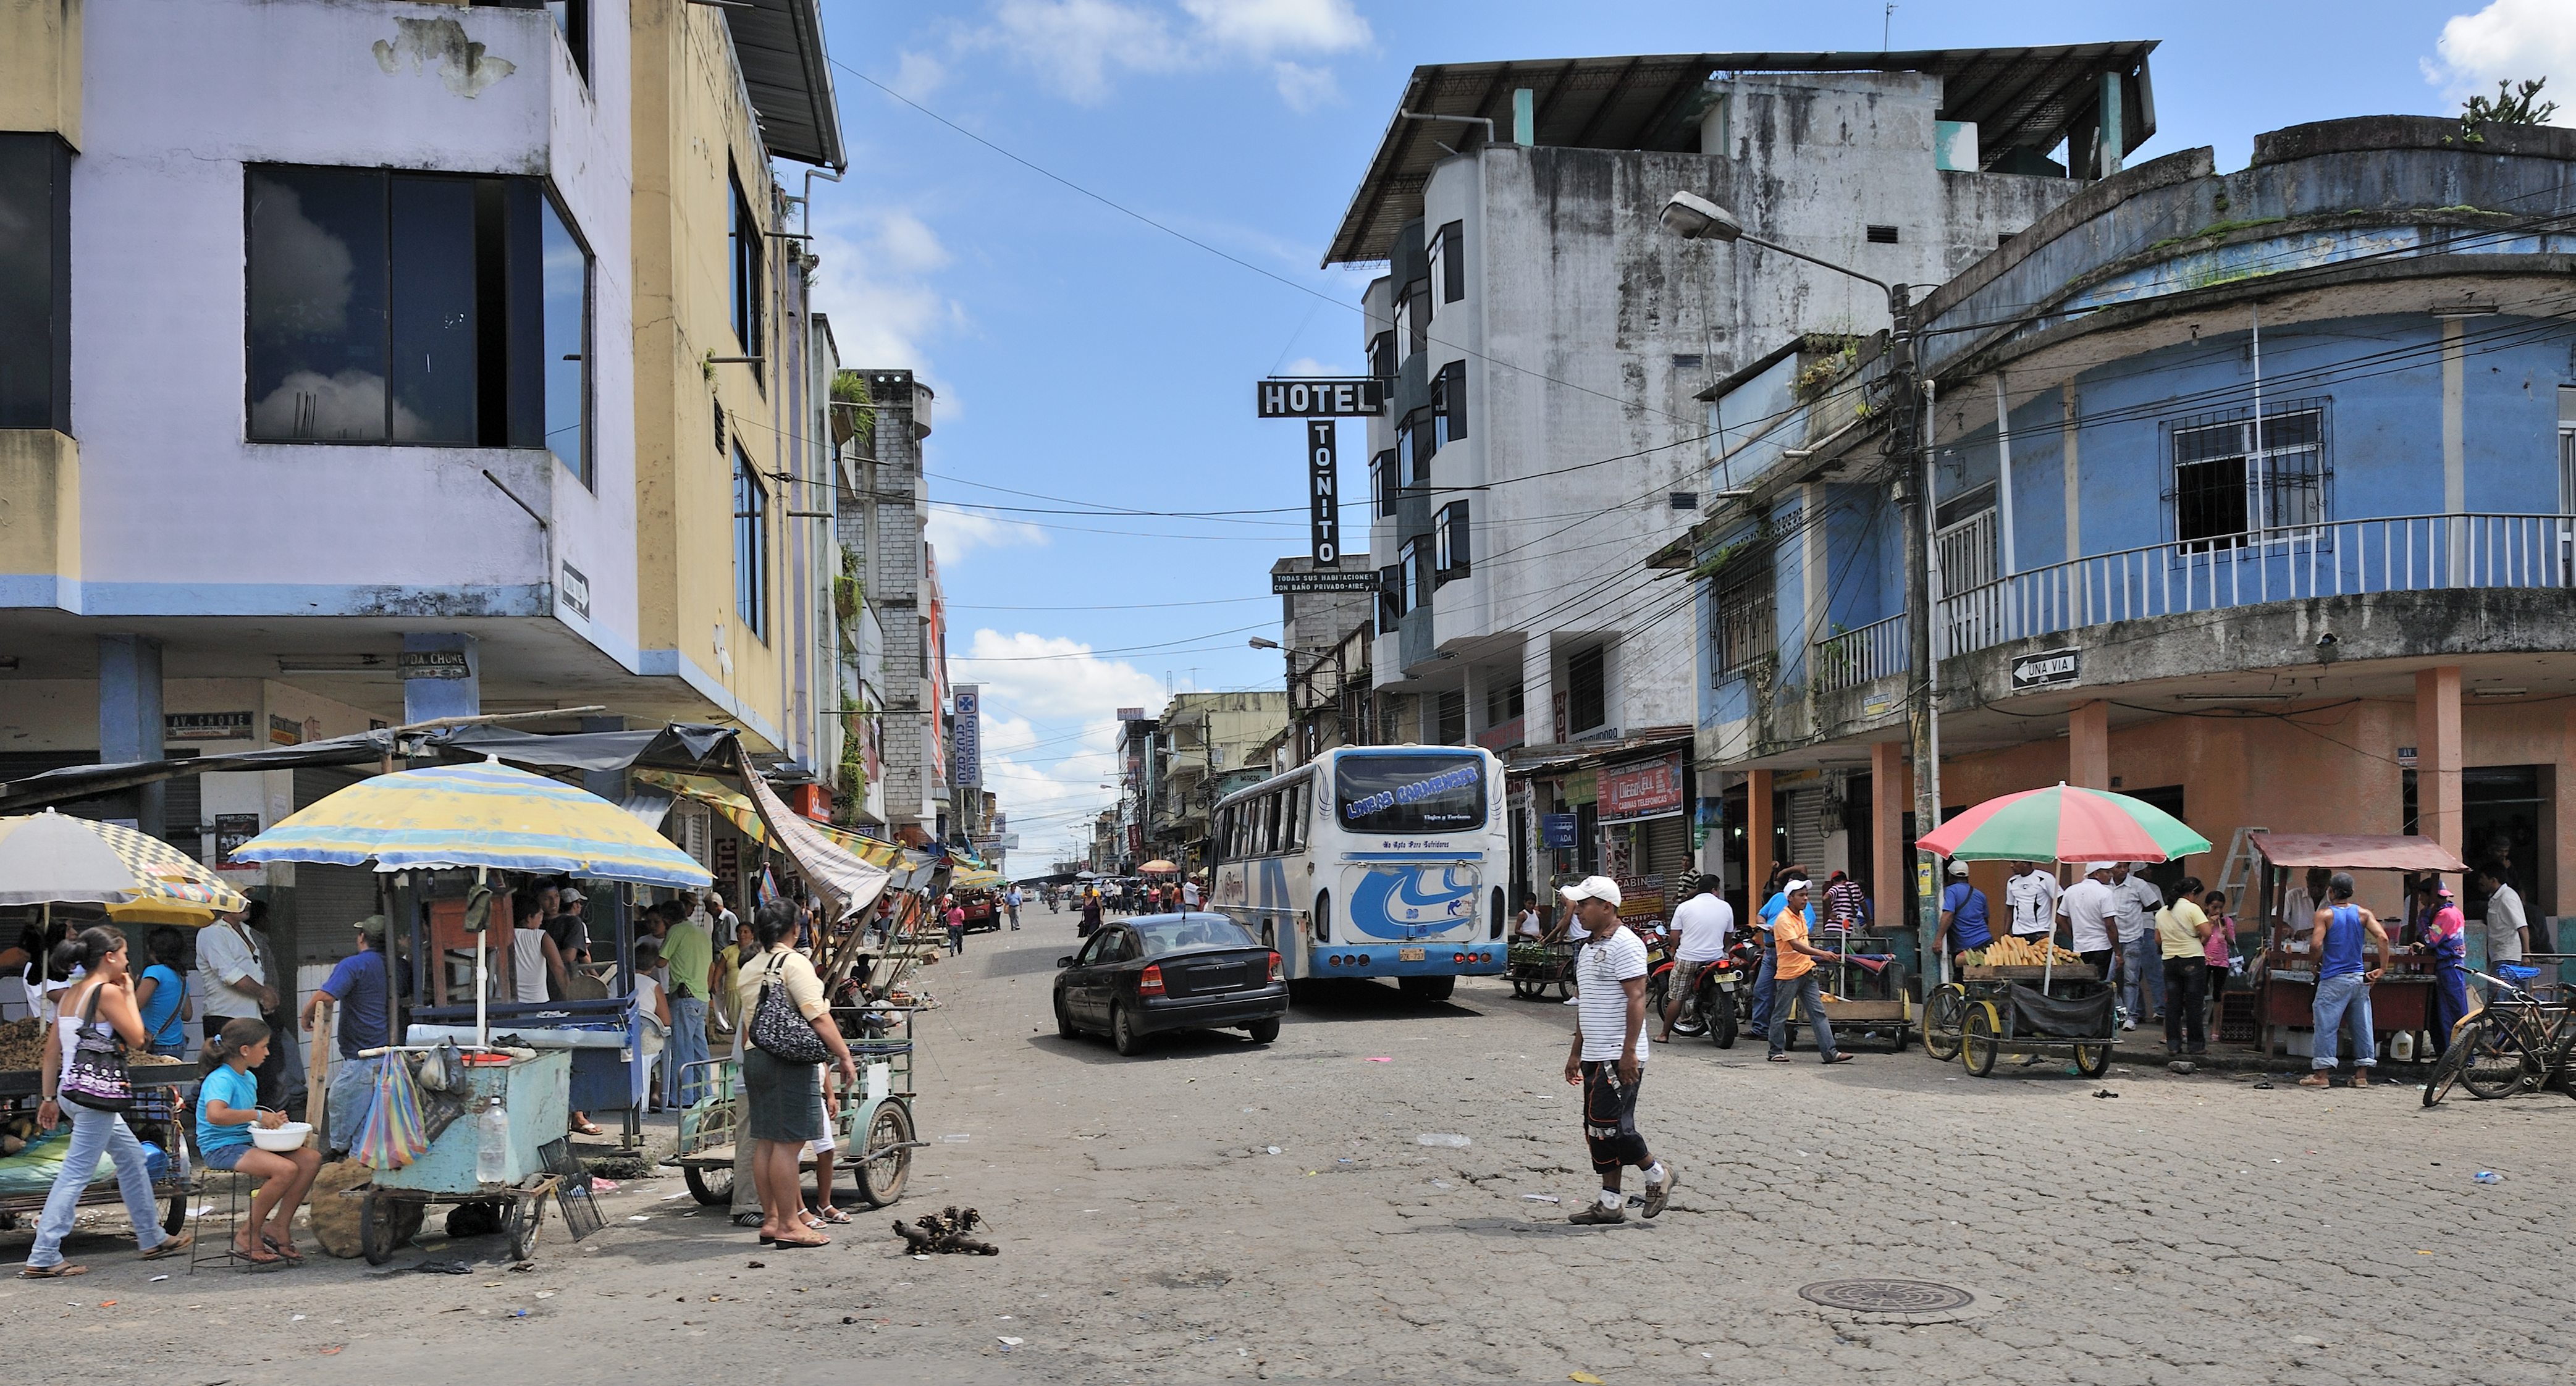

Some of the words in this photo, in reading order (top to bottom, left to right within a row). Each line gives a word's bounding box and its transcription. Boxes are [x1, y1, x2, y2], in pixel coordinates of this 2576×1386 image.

[1266, 384, 1377, 414] HOTEL
[1315, 425, 1334, 562] TOÑITO
[1292, 582, 1311, 590] BAÑO
[431, 654, 465, 665] CHONE
[2029, 663, 2047, 676] UNA
[2052, 658, 2068, 671] VIA
[174, 716, 190, 726] AV.
[198, 715, 243, 726] CHONE
[956, 724, 965, 753] cruz
[967, 715, 978, 780] farmacias
[958, 757, 970, 784] azul
[1346, 791, 1394, 819] LINEAS
[1396, 766, 1478, 804] CARMENSES
[1618, 800, 1637, 810] CABINAS
[1638, 795, 1667, 807] TELEFONICAS
[1622, 914, 1659, 923] CHIPS
